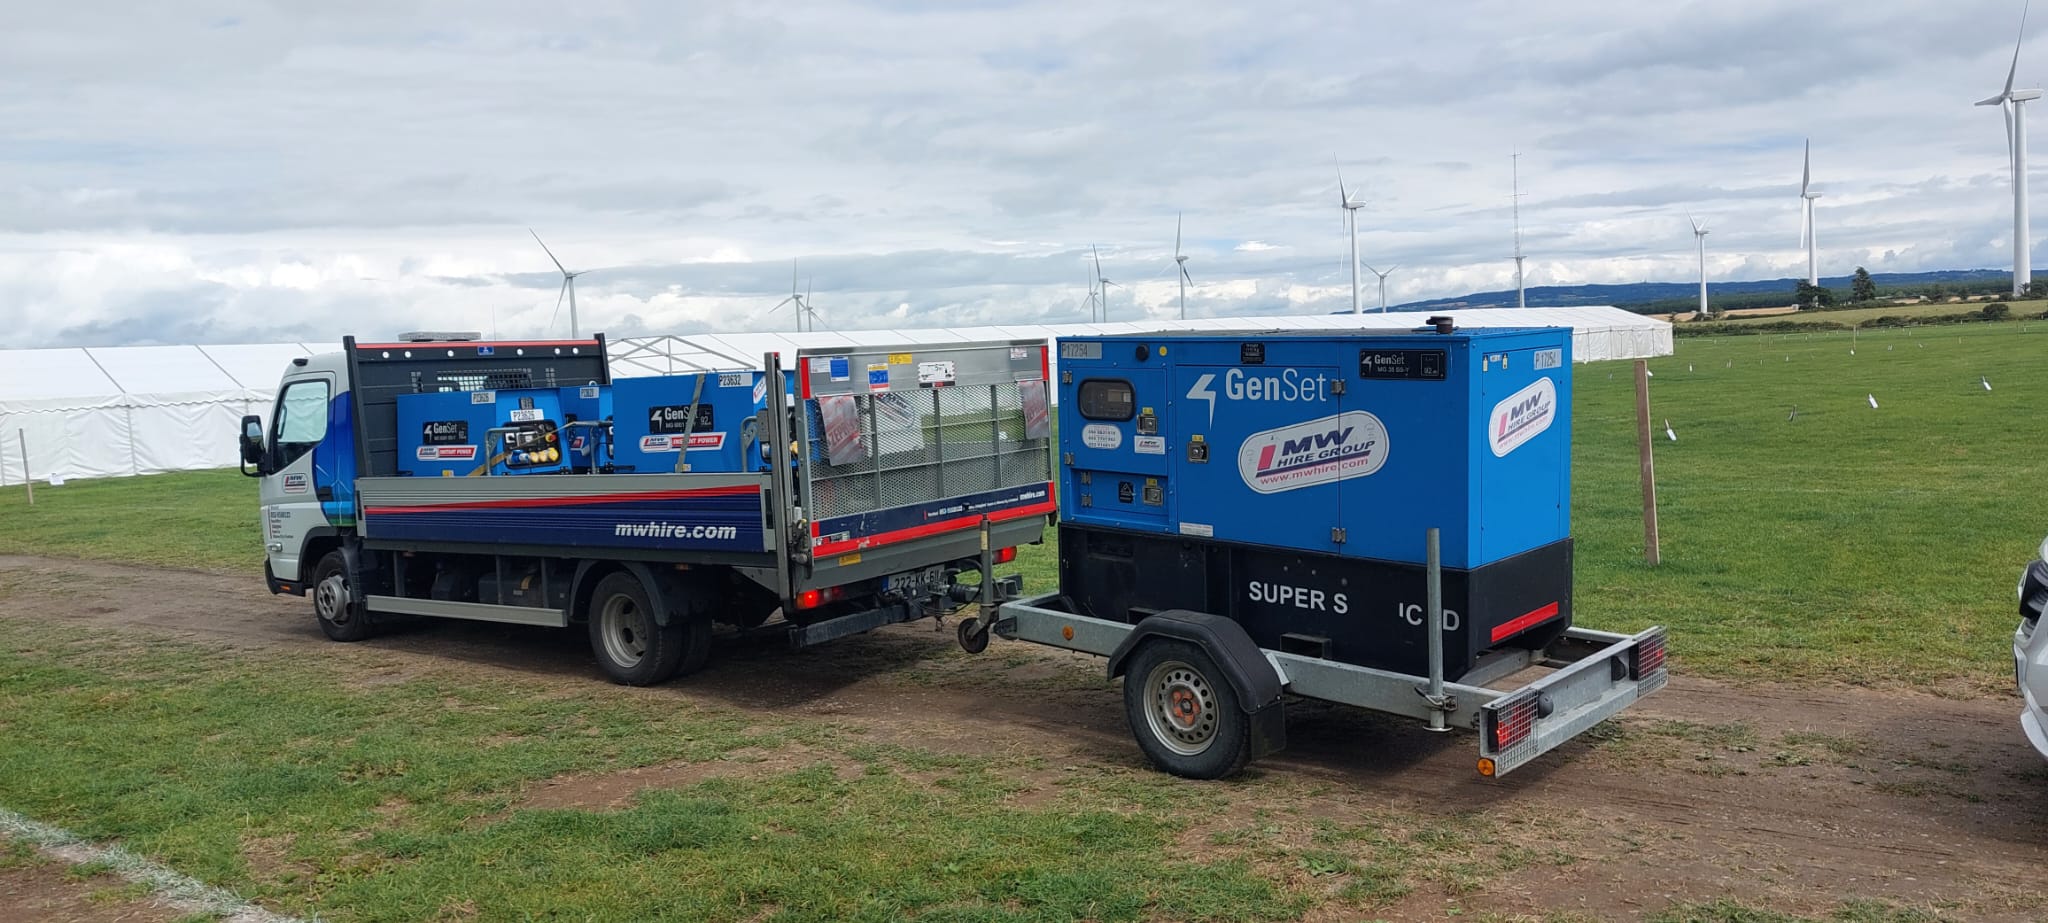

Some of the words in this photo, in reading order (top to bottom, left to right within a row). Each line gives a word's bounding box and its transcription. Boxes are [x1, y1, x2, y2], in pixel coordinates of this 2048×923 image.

[1374, 354, 1405, 364] GenSet
[719, 375, 741, 386] P23632
[1225, 367, 1327, 402] GenSet
[1508, 416, 1524, 431] HIRE
[1526, 400, 1551, 420] GROUP
[1510, 391, 1543, 421] MW
[433, 422, 457, 434] GenSet
[1282, 426, 1354, 457] MW
[1277, 451, 1314, 467] HIRE
[1318, 440, 1376, 459] GROUP
[1260, 458, 1368, 485] www.mwhire.com
[615, 521, 737, 539] mwhire.com
[1248, 581, 1326, 612] SUPER
